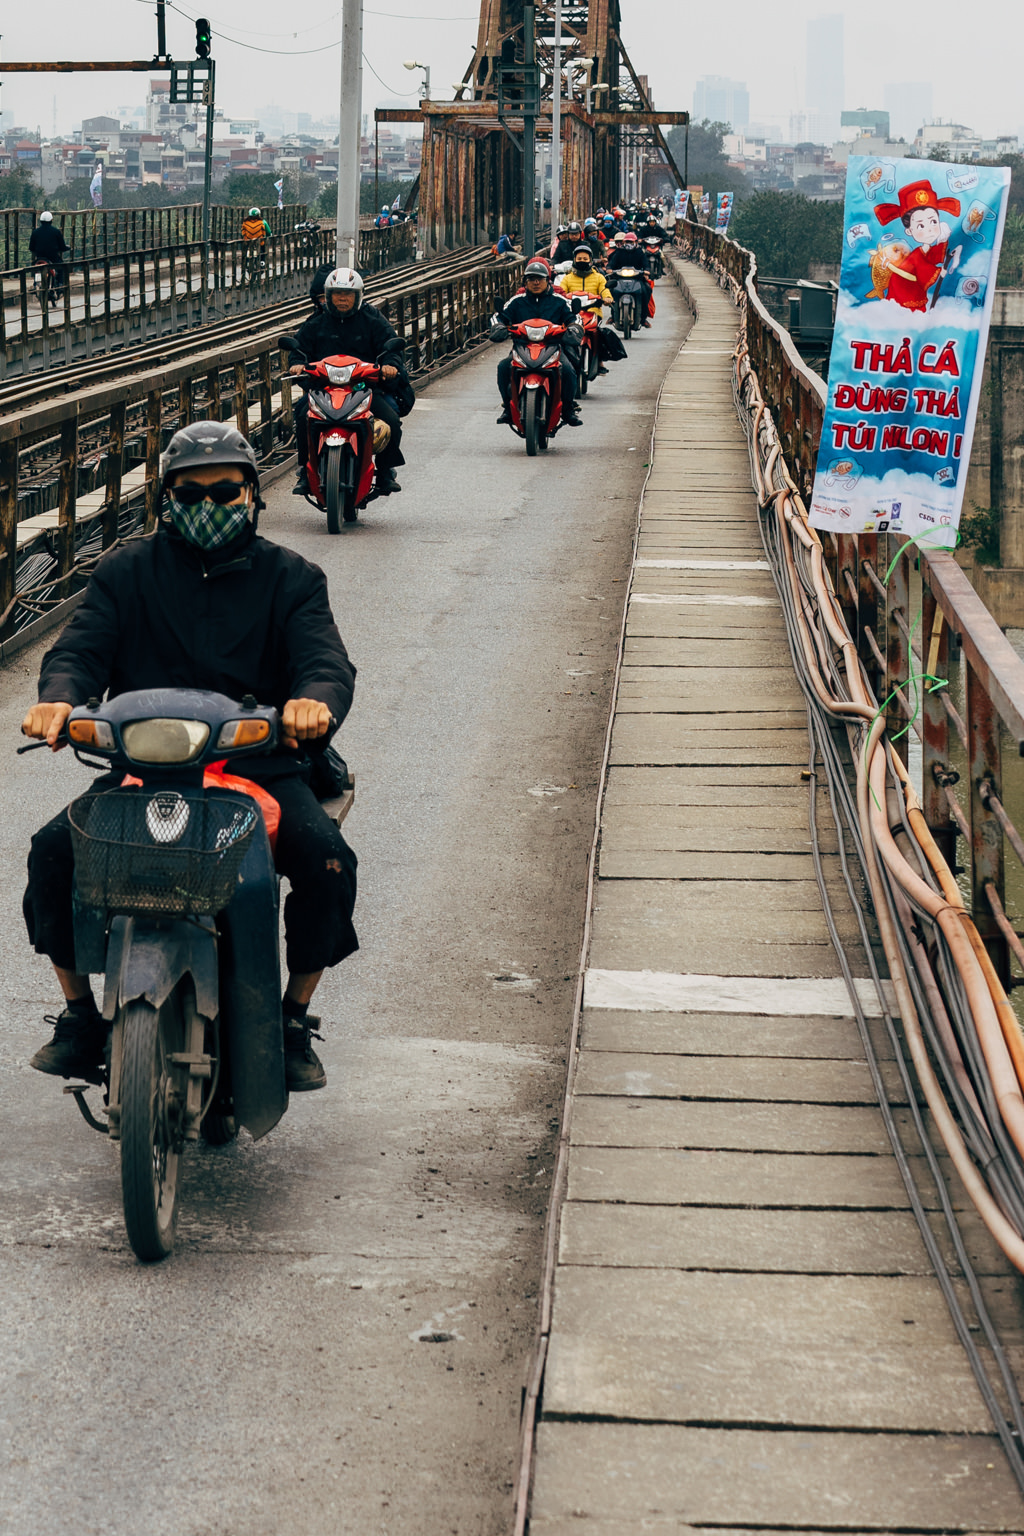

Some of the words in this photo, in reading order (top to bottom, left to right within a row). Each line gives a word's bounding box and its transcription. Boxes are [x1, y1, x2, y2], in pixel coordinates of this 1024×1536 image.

[850, 337, 913, 375] THẢ
[918, 340, 960, 377] CÁ
[834, 382, 907, 413] ĐỪNG
[913, 386, 960, 418] THẢ
[832, 421, 876, 451] TÚI
[881, 425, 949, 457] NILON
